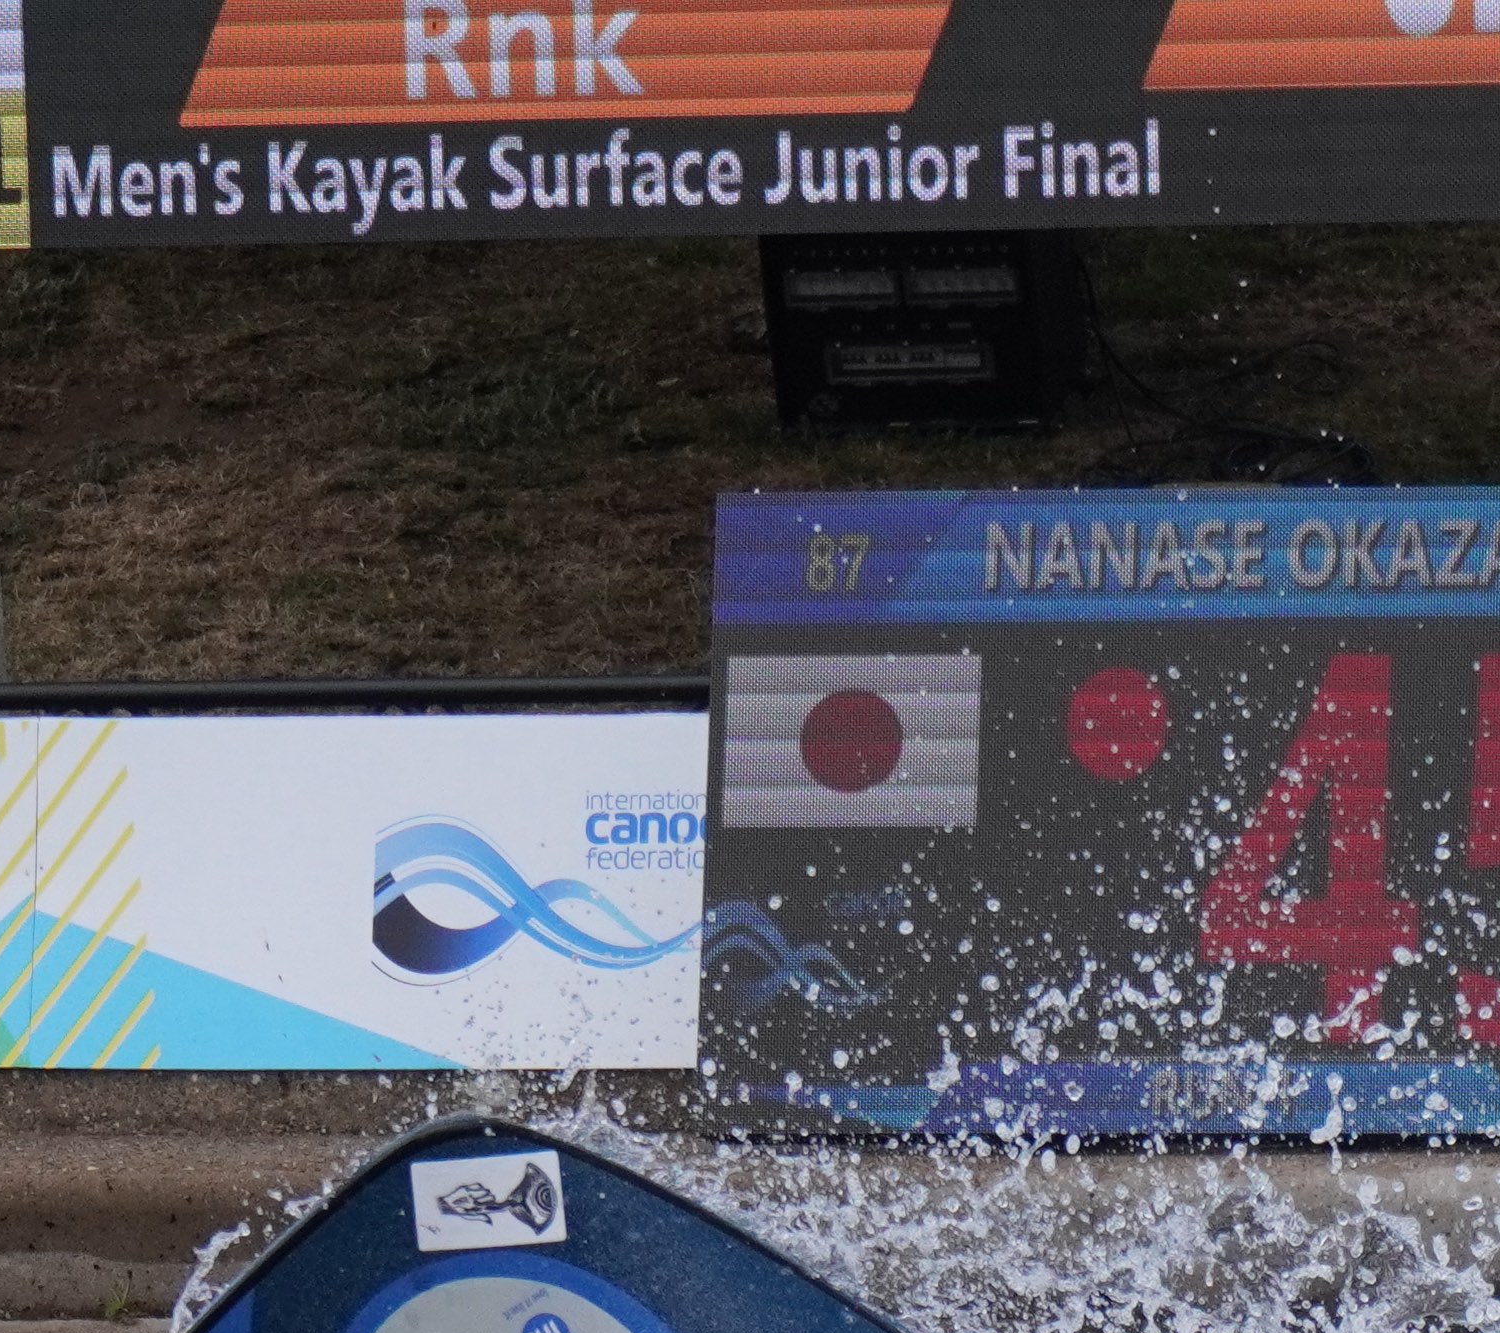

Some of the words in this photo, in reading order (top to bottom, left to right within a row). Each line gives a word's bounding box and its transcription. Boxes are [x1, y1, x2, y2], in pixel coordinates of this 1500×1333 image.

[50, 143, 245, 218] Men's
[268, 134, 467, 236] Kayak
[490, 129, 743, 212] Surface
[764, 125, 980, 204] Junior
[1003, 118, 1161, 199] Final
[807, 534, 869, 592] 87
[984, 519, 1268, 590] NANASE
[586, 791, 707, 811] internation
[586, 811, 708, 845] cano
